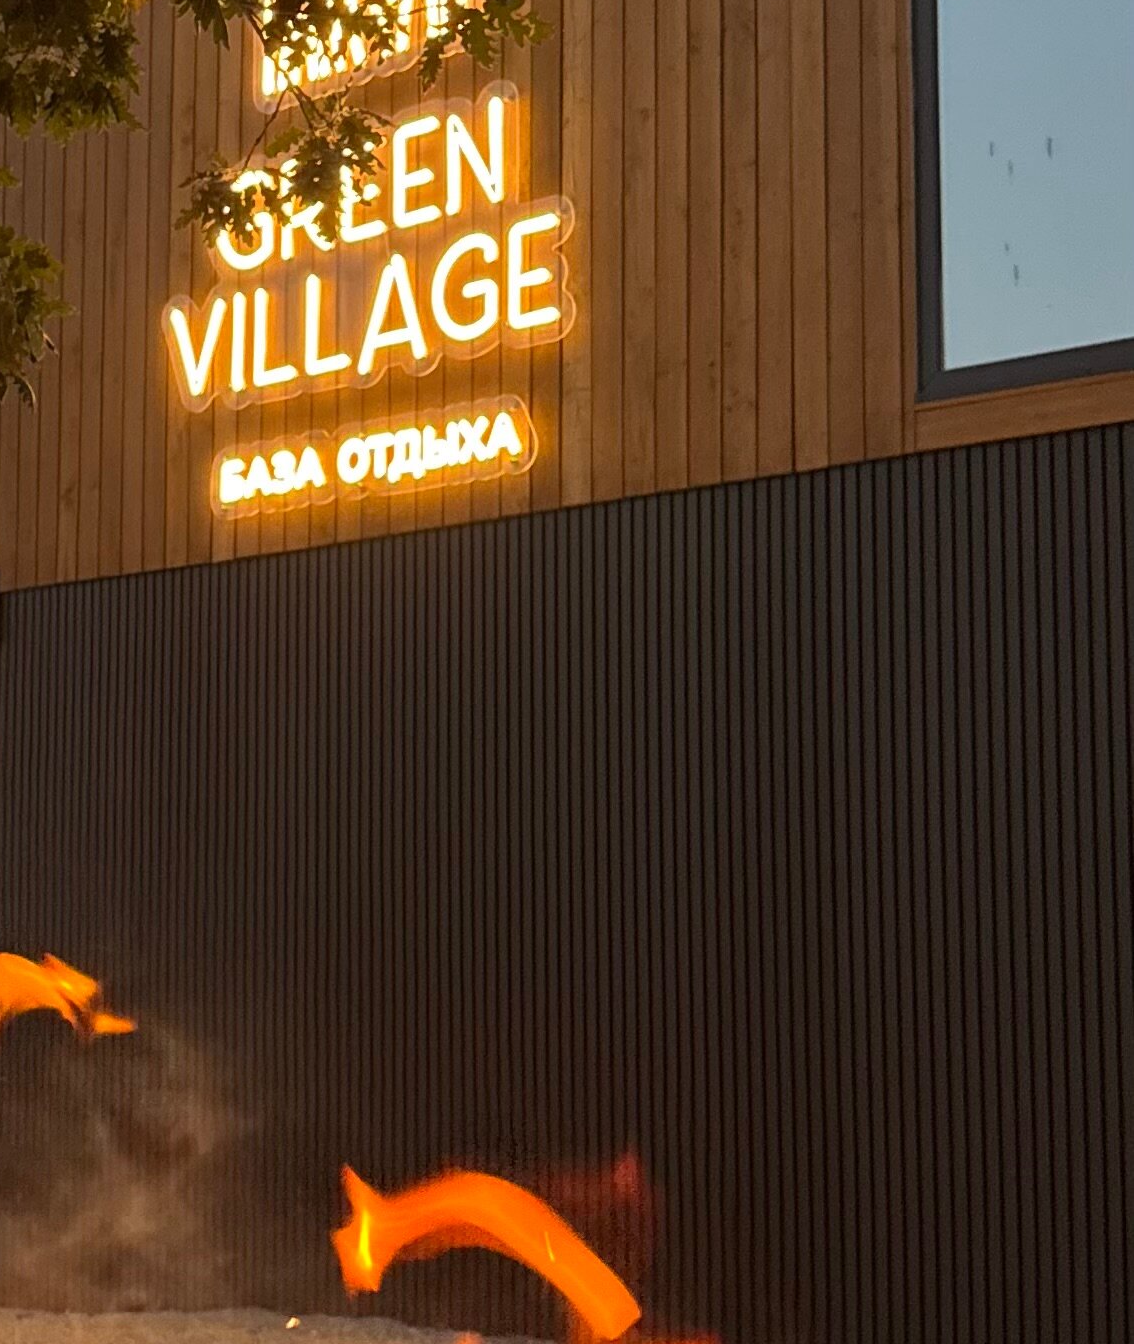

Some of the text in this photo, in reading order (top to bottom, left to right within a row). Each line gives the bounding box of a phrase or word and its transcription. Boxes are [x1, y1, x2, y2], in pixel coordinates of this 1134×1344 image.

[169, 212, 562, 396] VILLAGE
[219, 411, 523, 504] БАЗА ОТДЫХА
